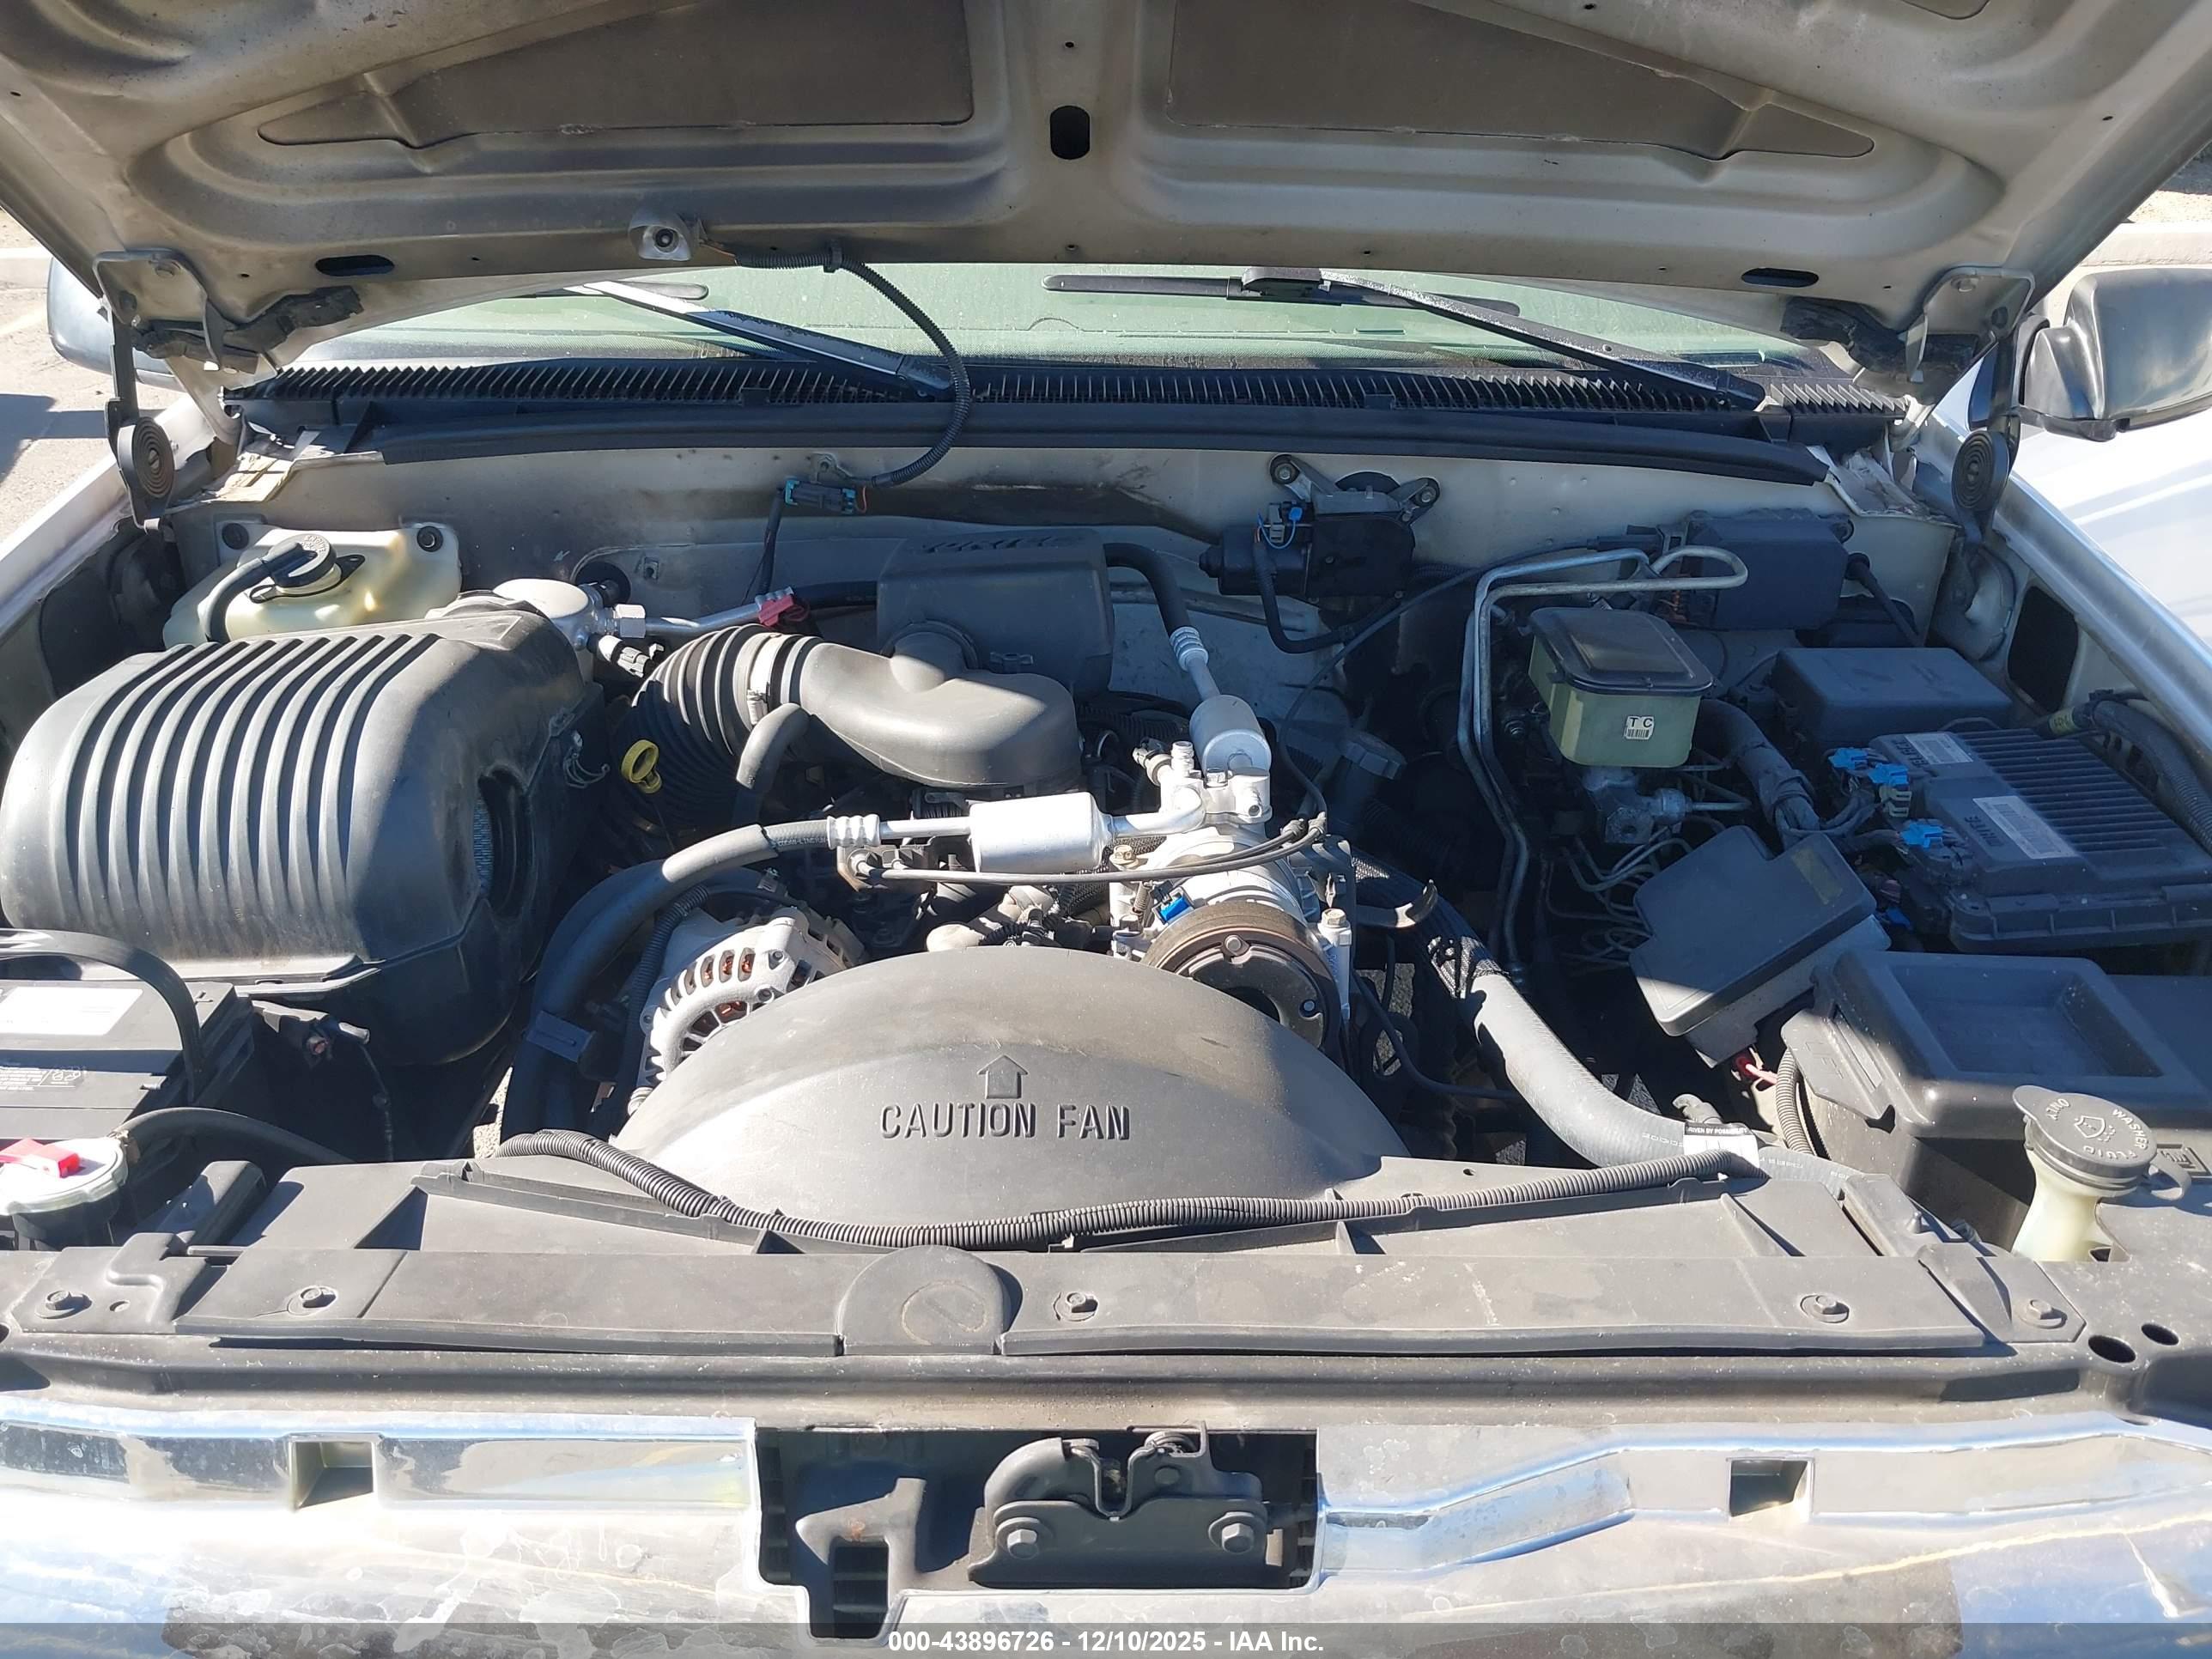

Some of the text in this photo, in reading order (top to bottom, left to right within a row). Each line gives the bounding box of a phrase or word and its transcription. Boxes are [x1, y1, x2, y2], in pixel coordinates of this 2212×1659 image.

[1629, 717, 1653, 728] T C
[880, 1102, 1131, 1141] CAUTION FAN
[2045, 1097, 2071, 1121] ONLY
[2112, 1108, 2149, 1151] WASHER
